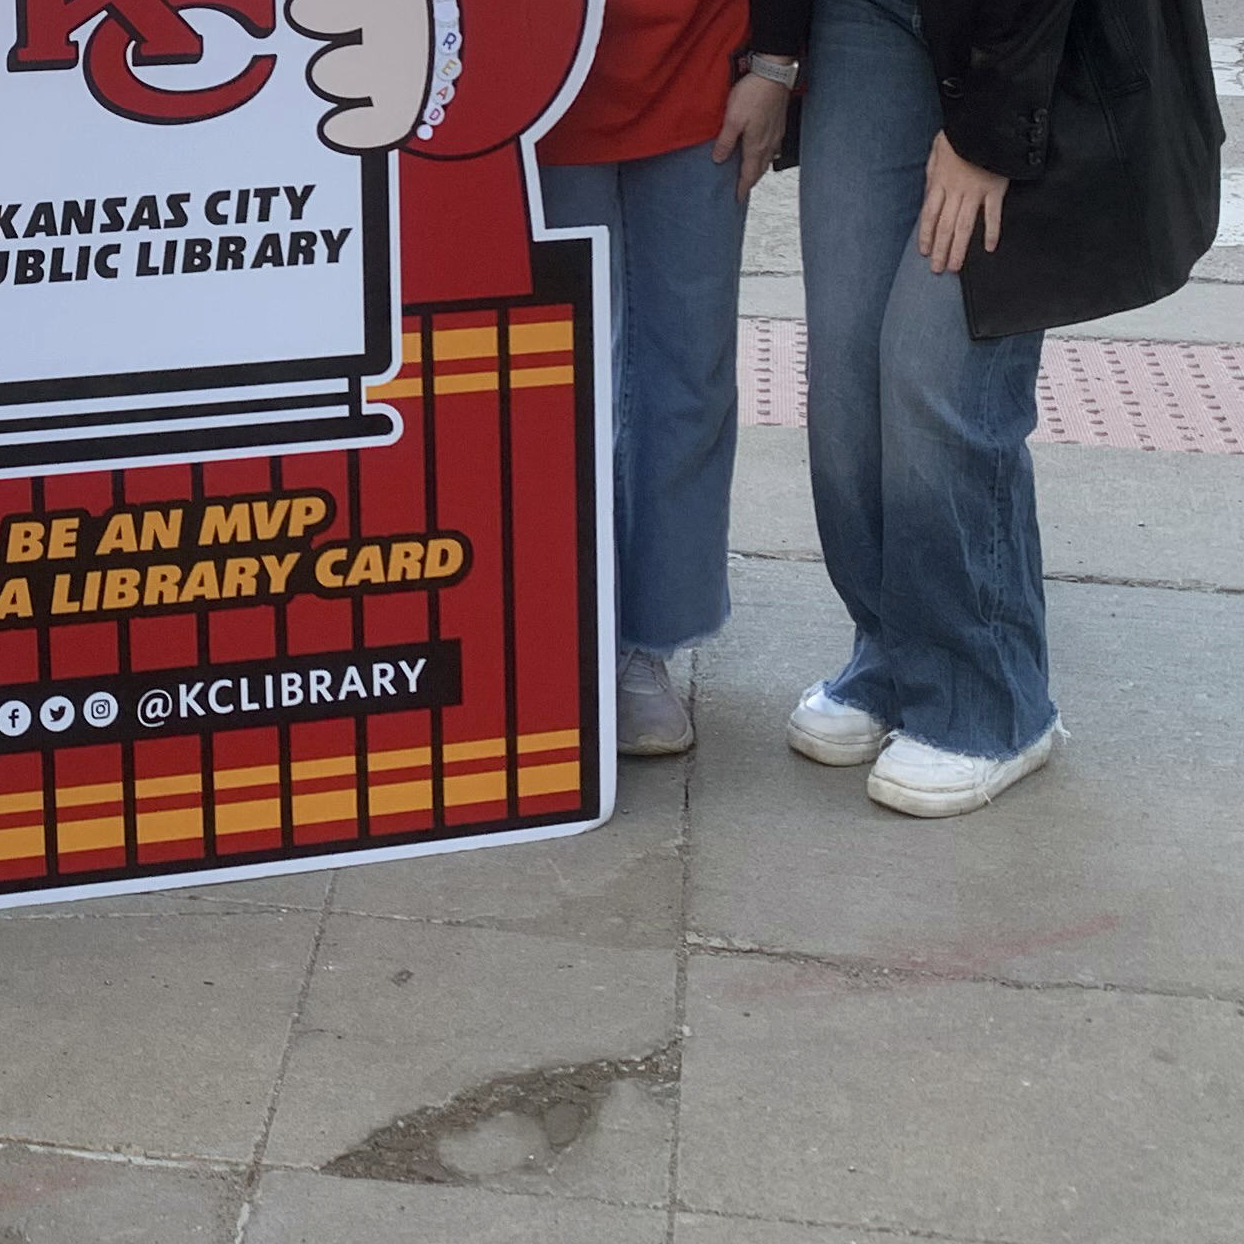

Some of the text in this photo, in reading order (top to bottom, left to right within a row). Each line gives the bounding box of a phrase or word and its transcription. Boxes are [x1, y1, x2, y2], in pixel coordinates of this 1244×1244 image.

[429, 32, 457, 121] READ
[204, 184, 317, 224] CITY
[135, 228, 353, 277] LIBRARY
[6, 496, 327, 563] BE AN MVP
[51, 552, 301, 615] LIBRARY
[315, 538, 464, 588] CARD
[137, 658, 427, 727] @KCLIBRARY
